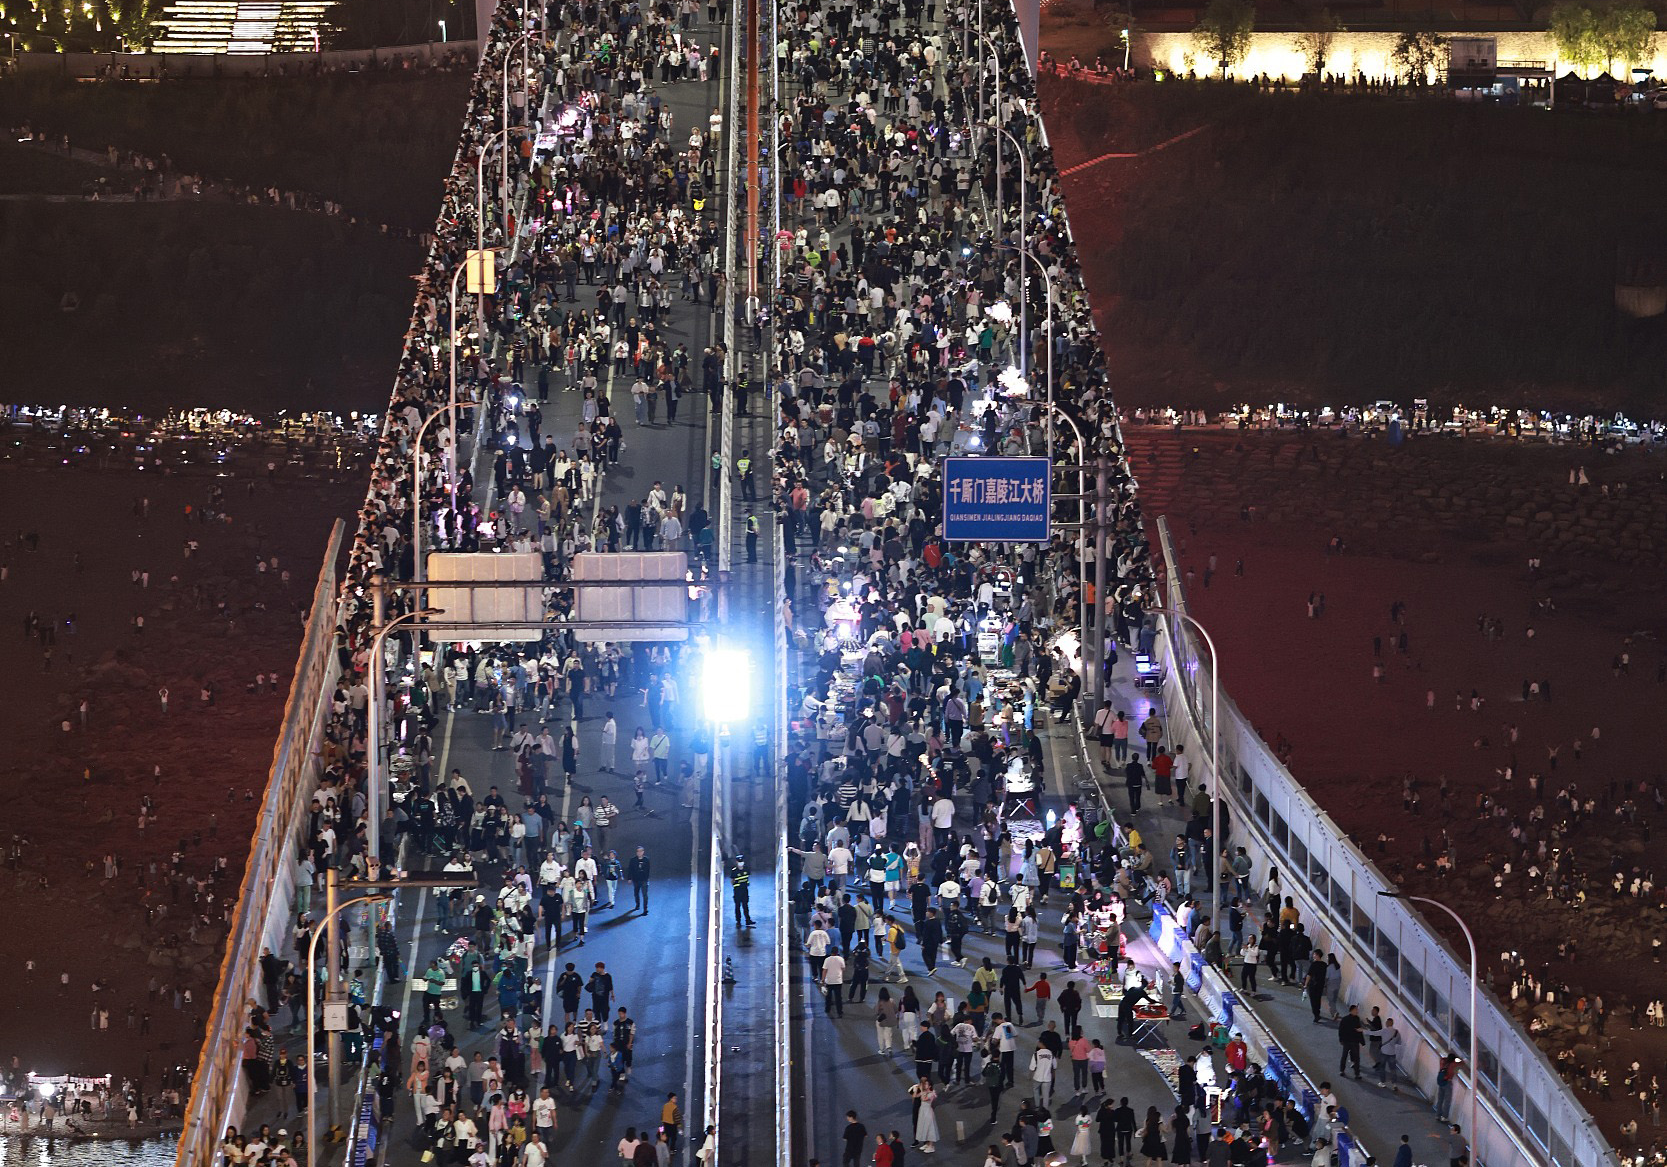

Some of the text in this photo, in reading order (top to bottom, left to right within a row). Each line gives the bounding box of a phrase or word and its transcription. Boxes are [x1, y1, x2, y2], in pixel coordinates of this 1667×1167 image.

[949, 477, 1045, 505] 千厮门嘉陵江大桥
[950, 514, 1043, 522] QIANSIMEN JIALINGJIANG DAQIAO
